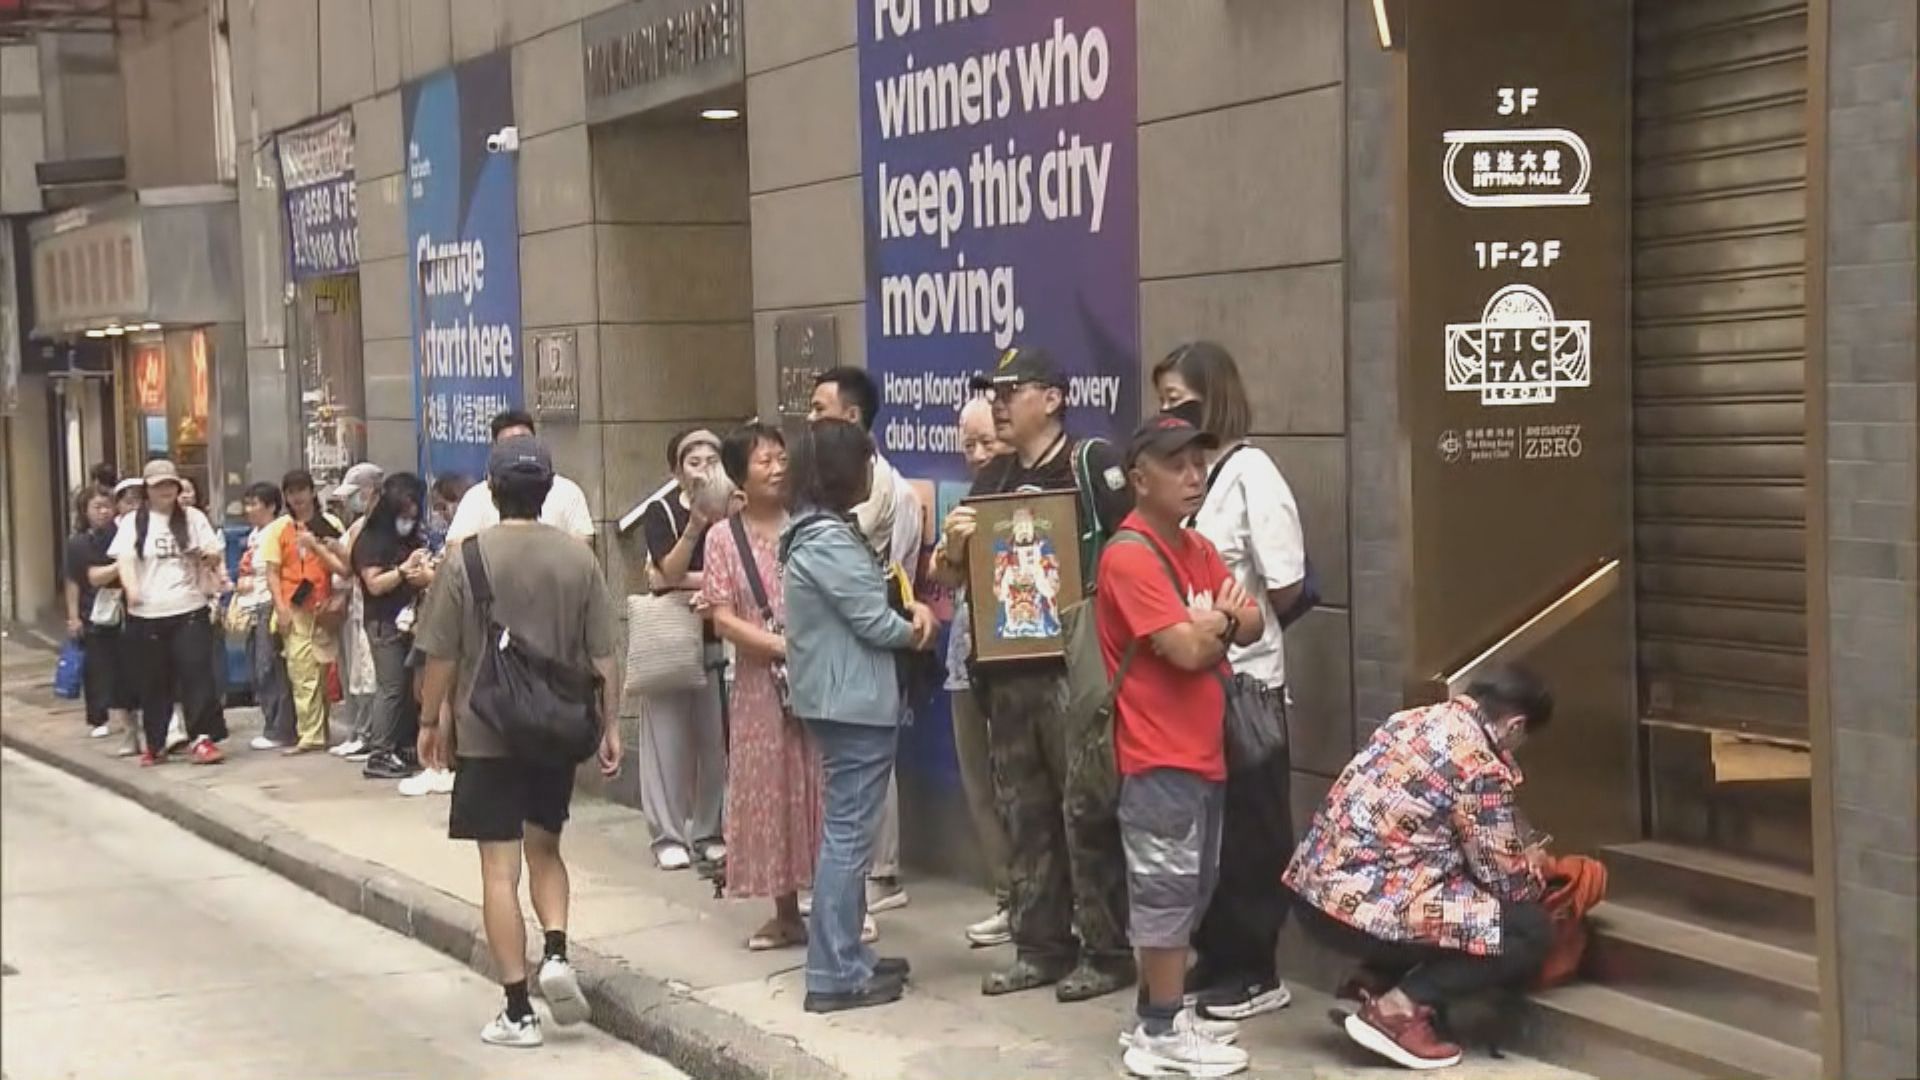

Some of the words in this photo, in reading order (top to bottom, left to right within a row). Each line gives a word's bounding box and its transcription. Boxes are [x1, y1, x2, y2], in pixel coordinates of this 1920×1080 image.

[875, 48, 1011, 139] winners
[1016, 17, 1109, 112] who
[1497, 87, 1538, 115] 3F
[879, 162, 964, 248] keep
[969, 138, 1032, 228] this
[1039, 129, 1112, 232] city
[1528, 171, 1562, 186] HALL
[417, 234, 484, 306] Change
[1474, 240, 1560, 269] 1F-2F
[881, 251, 1024, 349] moving.
[469, 311, 513, 378] here
[1489, 330, 1547, 353] TIC
[1489, 360, 1547, 381] TAC
[884, 371, 921, 410] Hong
[925, 370, 970, 410] Kong's
[1066, 375, 1120, 414] overy
[886, 417, 914, 450] club
[917, 418, 927, 449] is
[929, 425, 963, 452] com
[1525, 424, 1580, 438] sensory
[1525, 438, 1582, 459] ZERO
